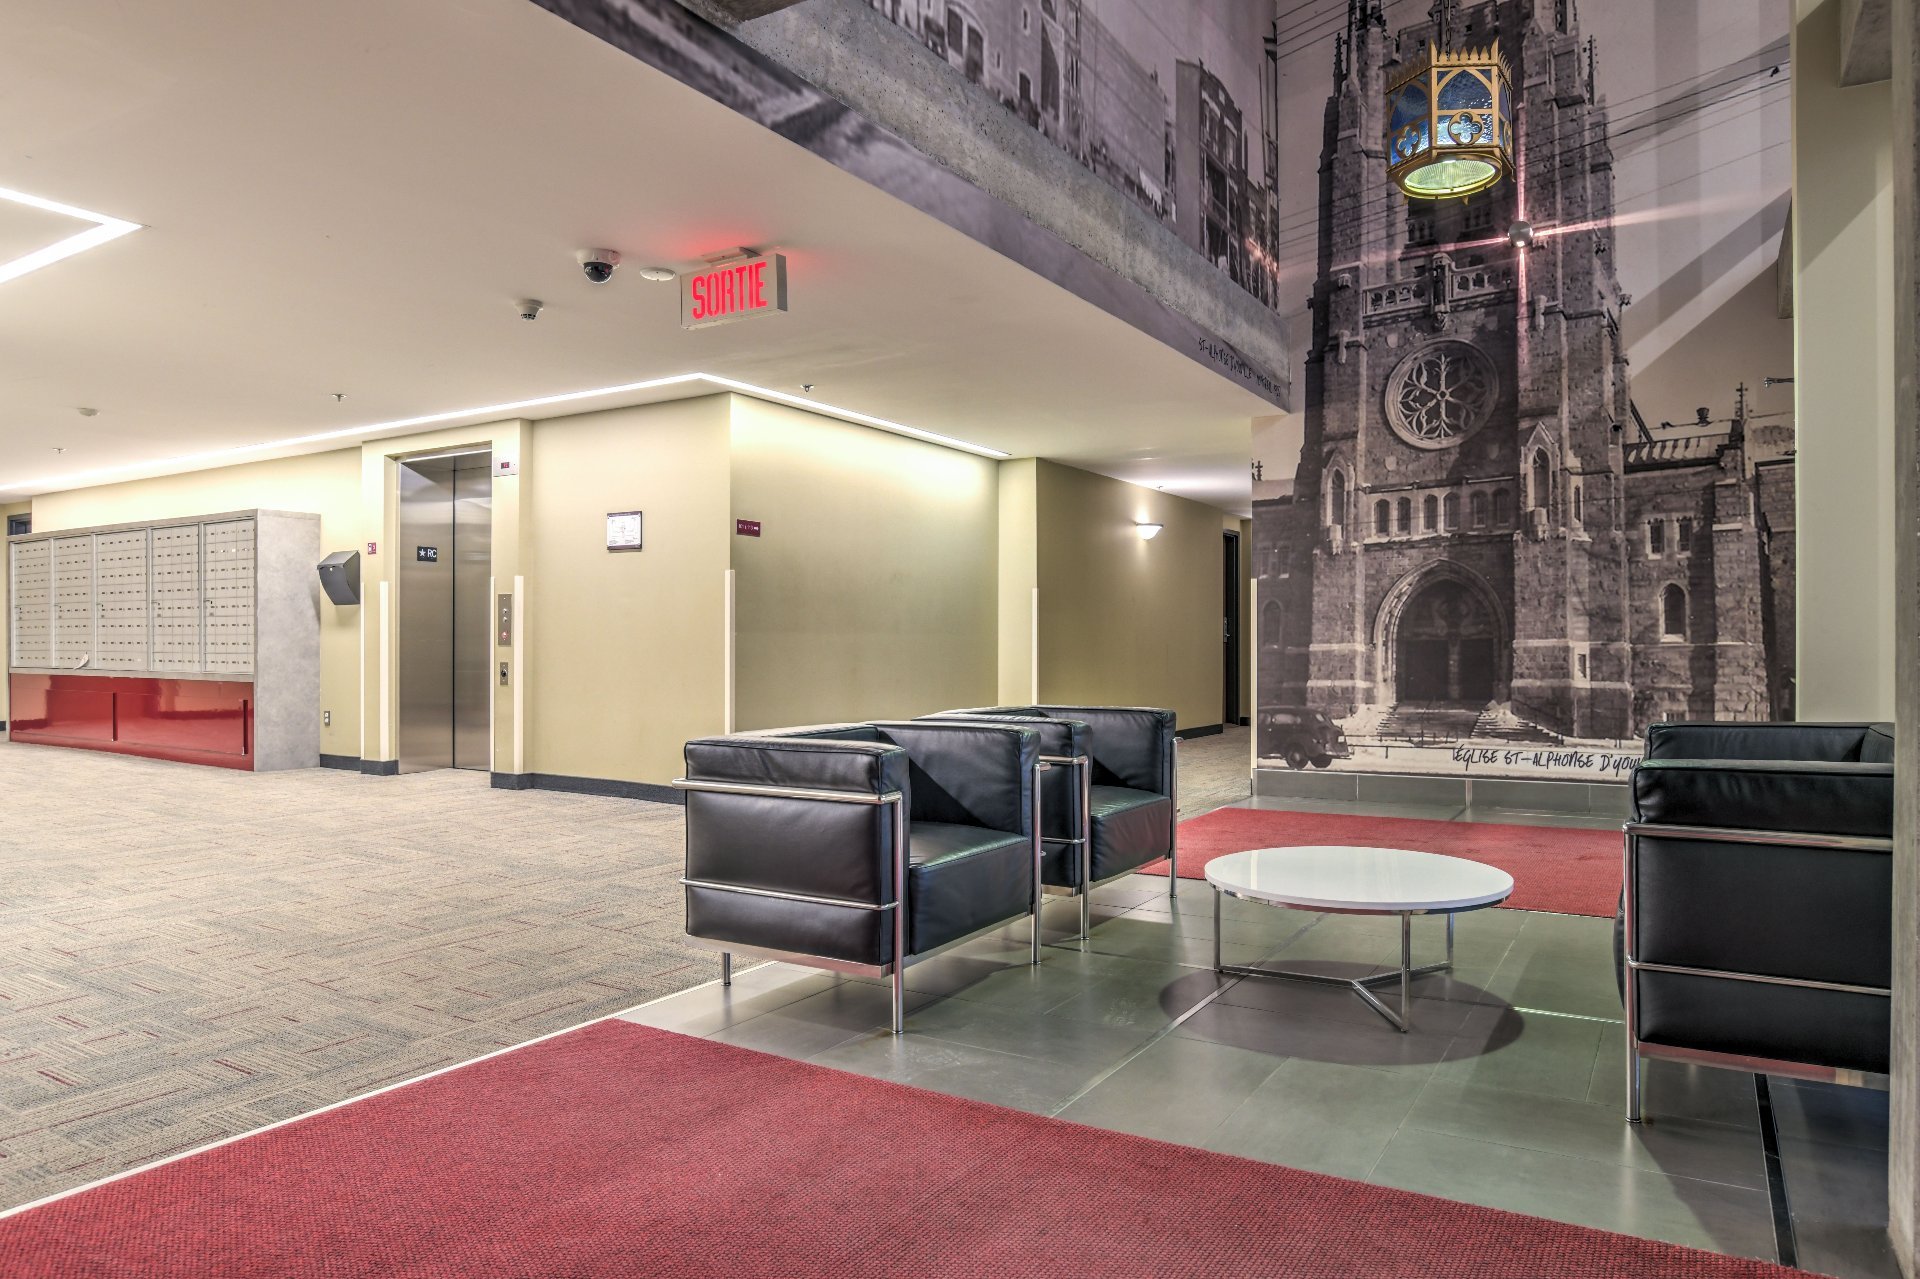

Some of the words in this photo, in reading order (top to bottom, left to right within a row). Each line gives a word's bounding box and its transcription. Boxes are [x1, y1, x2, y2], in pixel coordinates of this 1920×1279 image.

[692, 261, 768, 320] SORTIE
[427, 548, 437, 558] RC
[1504, 750, 1594, 770] ST-ALPHONSE
